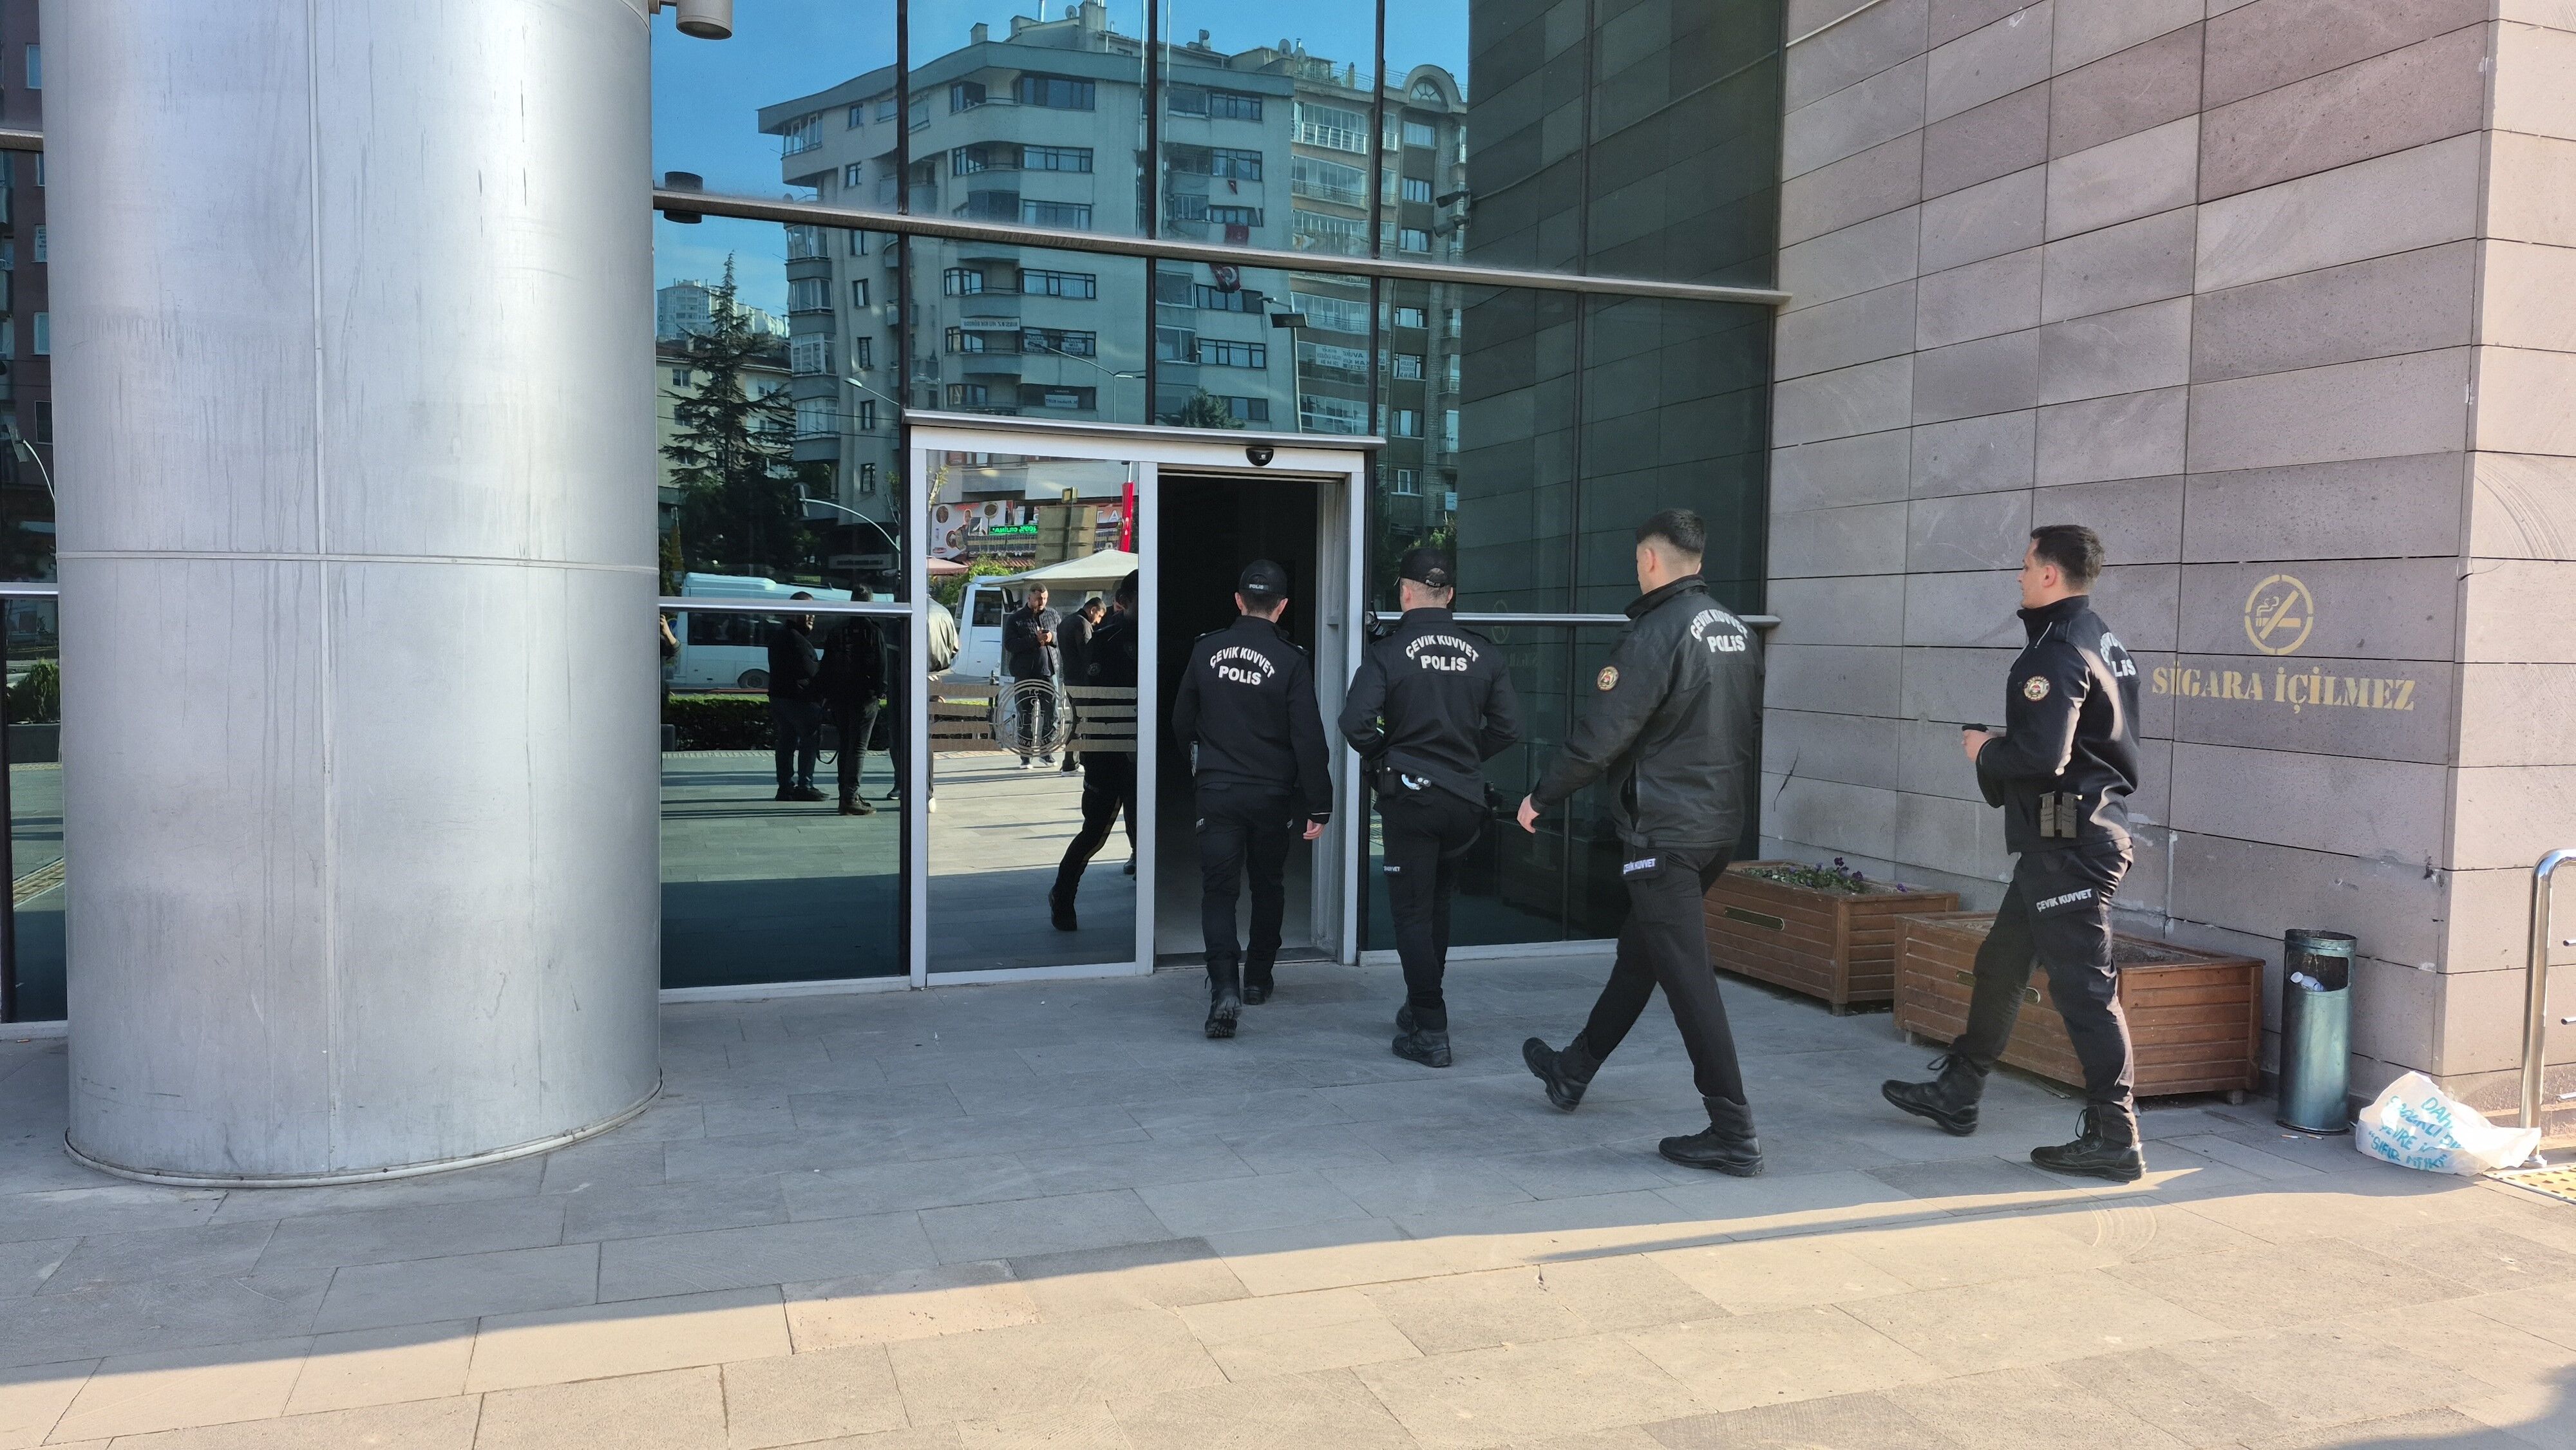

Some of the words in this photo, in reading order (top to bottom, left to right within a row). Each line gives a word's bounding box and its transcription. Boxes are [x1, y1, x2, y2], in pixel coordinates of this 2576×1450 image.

[1690, 609, 1715, 642] ÇEVİK
[1406, 635, 1437, 660] ÇEVİK
[1435, 635, 1479, 663] KUVVET
[1706, 635, 1746, 653] POLİS
[1209, 646, 1240, 669] ÇEVİK
[1239, 647, 1275, 678] KUVVET
[1218, 665, 1262, 685] POLİS
[1420, 655, 1468, 672] POLİS
[2111, 659, 2137, 677] LİS
[2152, 661, 2263, 701] SİGARA
[2274, 666, 2416, 714] İÇİLMEZ
[2036, 897, 2059, 912] ÇEVİK
[2058, 888, 2092, 905] KUVVET
[2421, 1097, 2453, 1128] DAH
